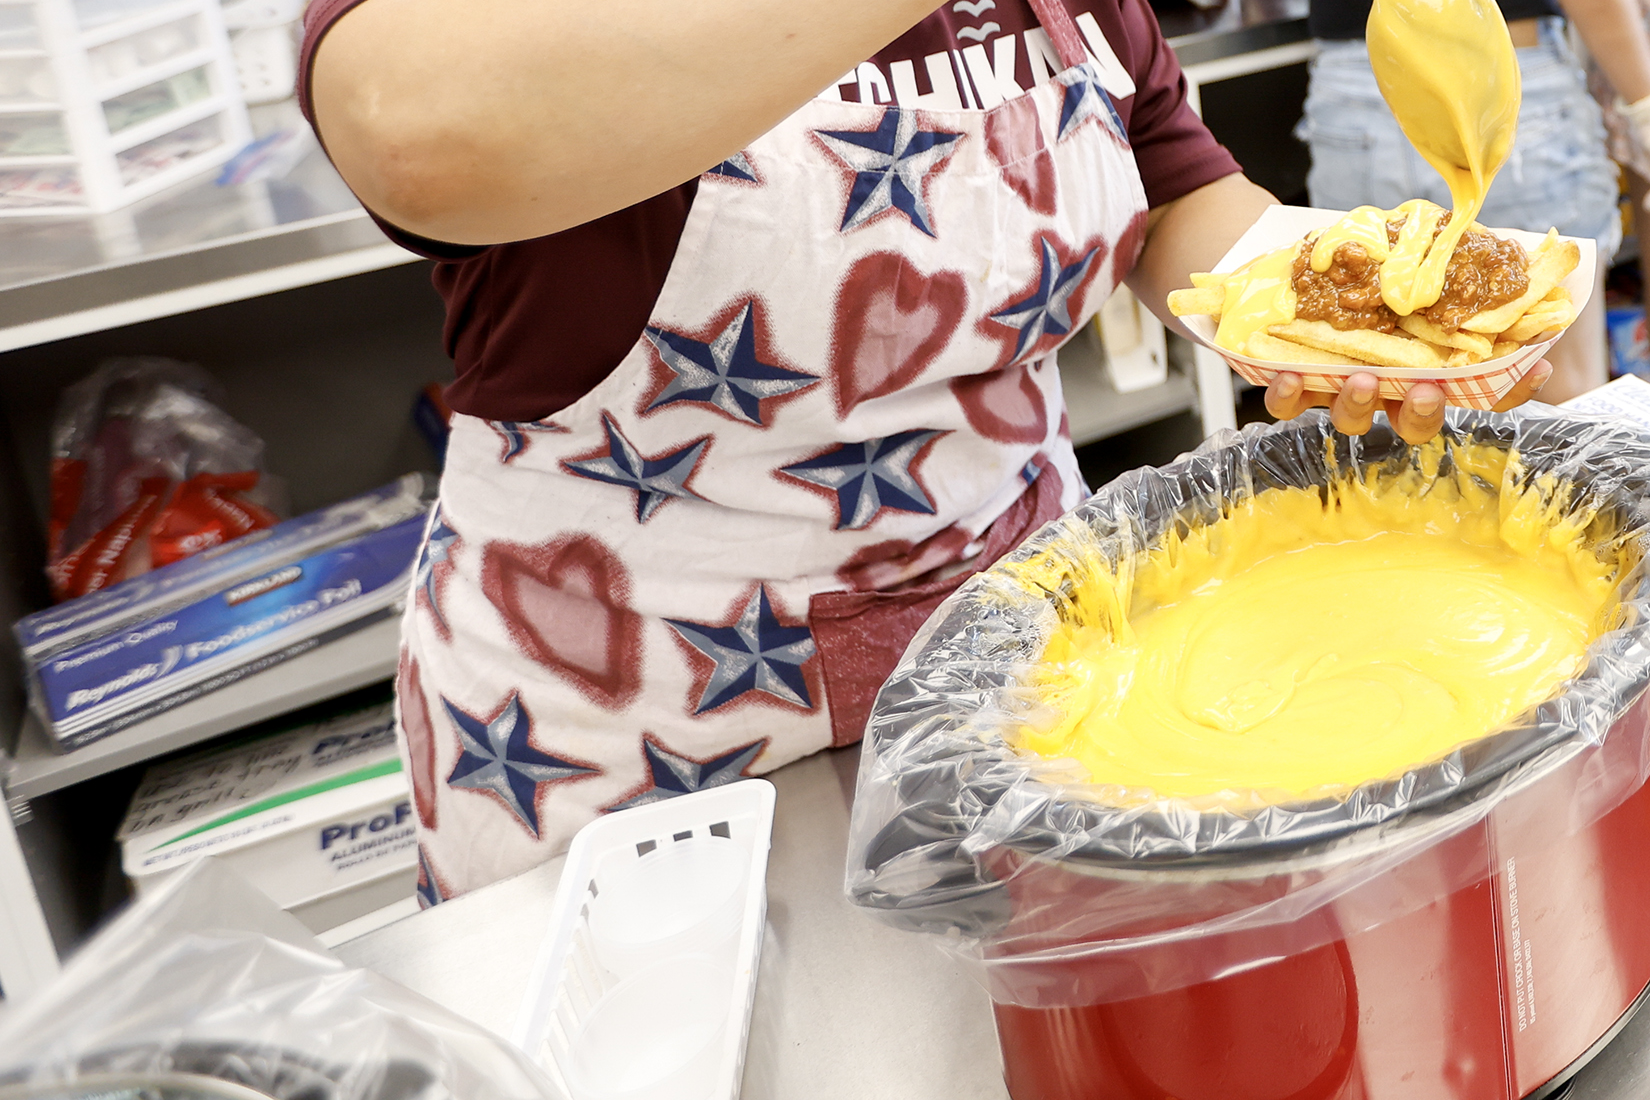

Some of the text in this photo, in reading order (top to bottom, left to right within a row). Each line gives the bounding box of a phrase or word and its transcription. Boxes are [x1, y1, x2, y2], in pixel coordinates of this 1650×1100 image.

[184, 578, 363, 659] Foodservice Foil
[53, 619, 179, 674] Premium Quality
[65, 662, 160, 712] Reynolds
[1506, 856, 1516, 889] BURNER
[1509, 889, 1518, 915] STOVE
[1511, 927, 1521, 948] BASE
[1513, 961, 1524, 987] CROCK
[1515, 988, 1525, 1002] PUT
[1517, 1003, 1526, 1018] NOT
